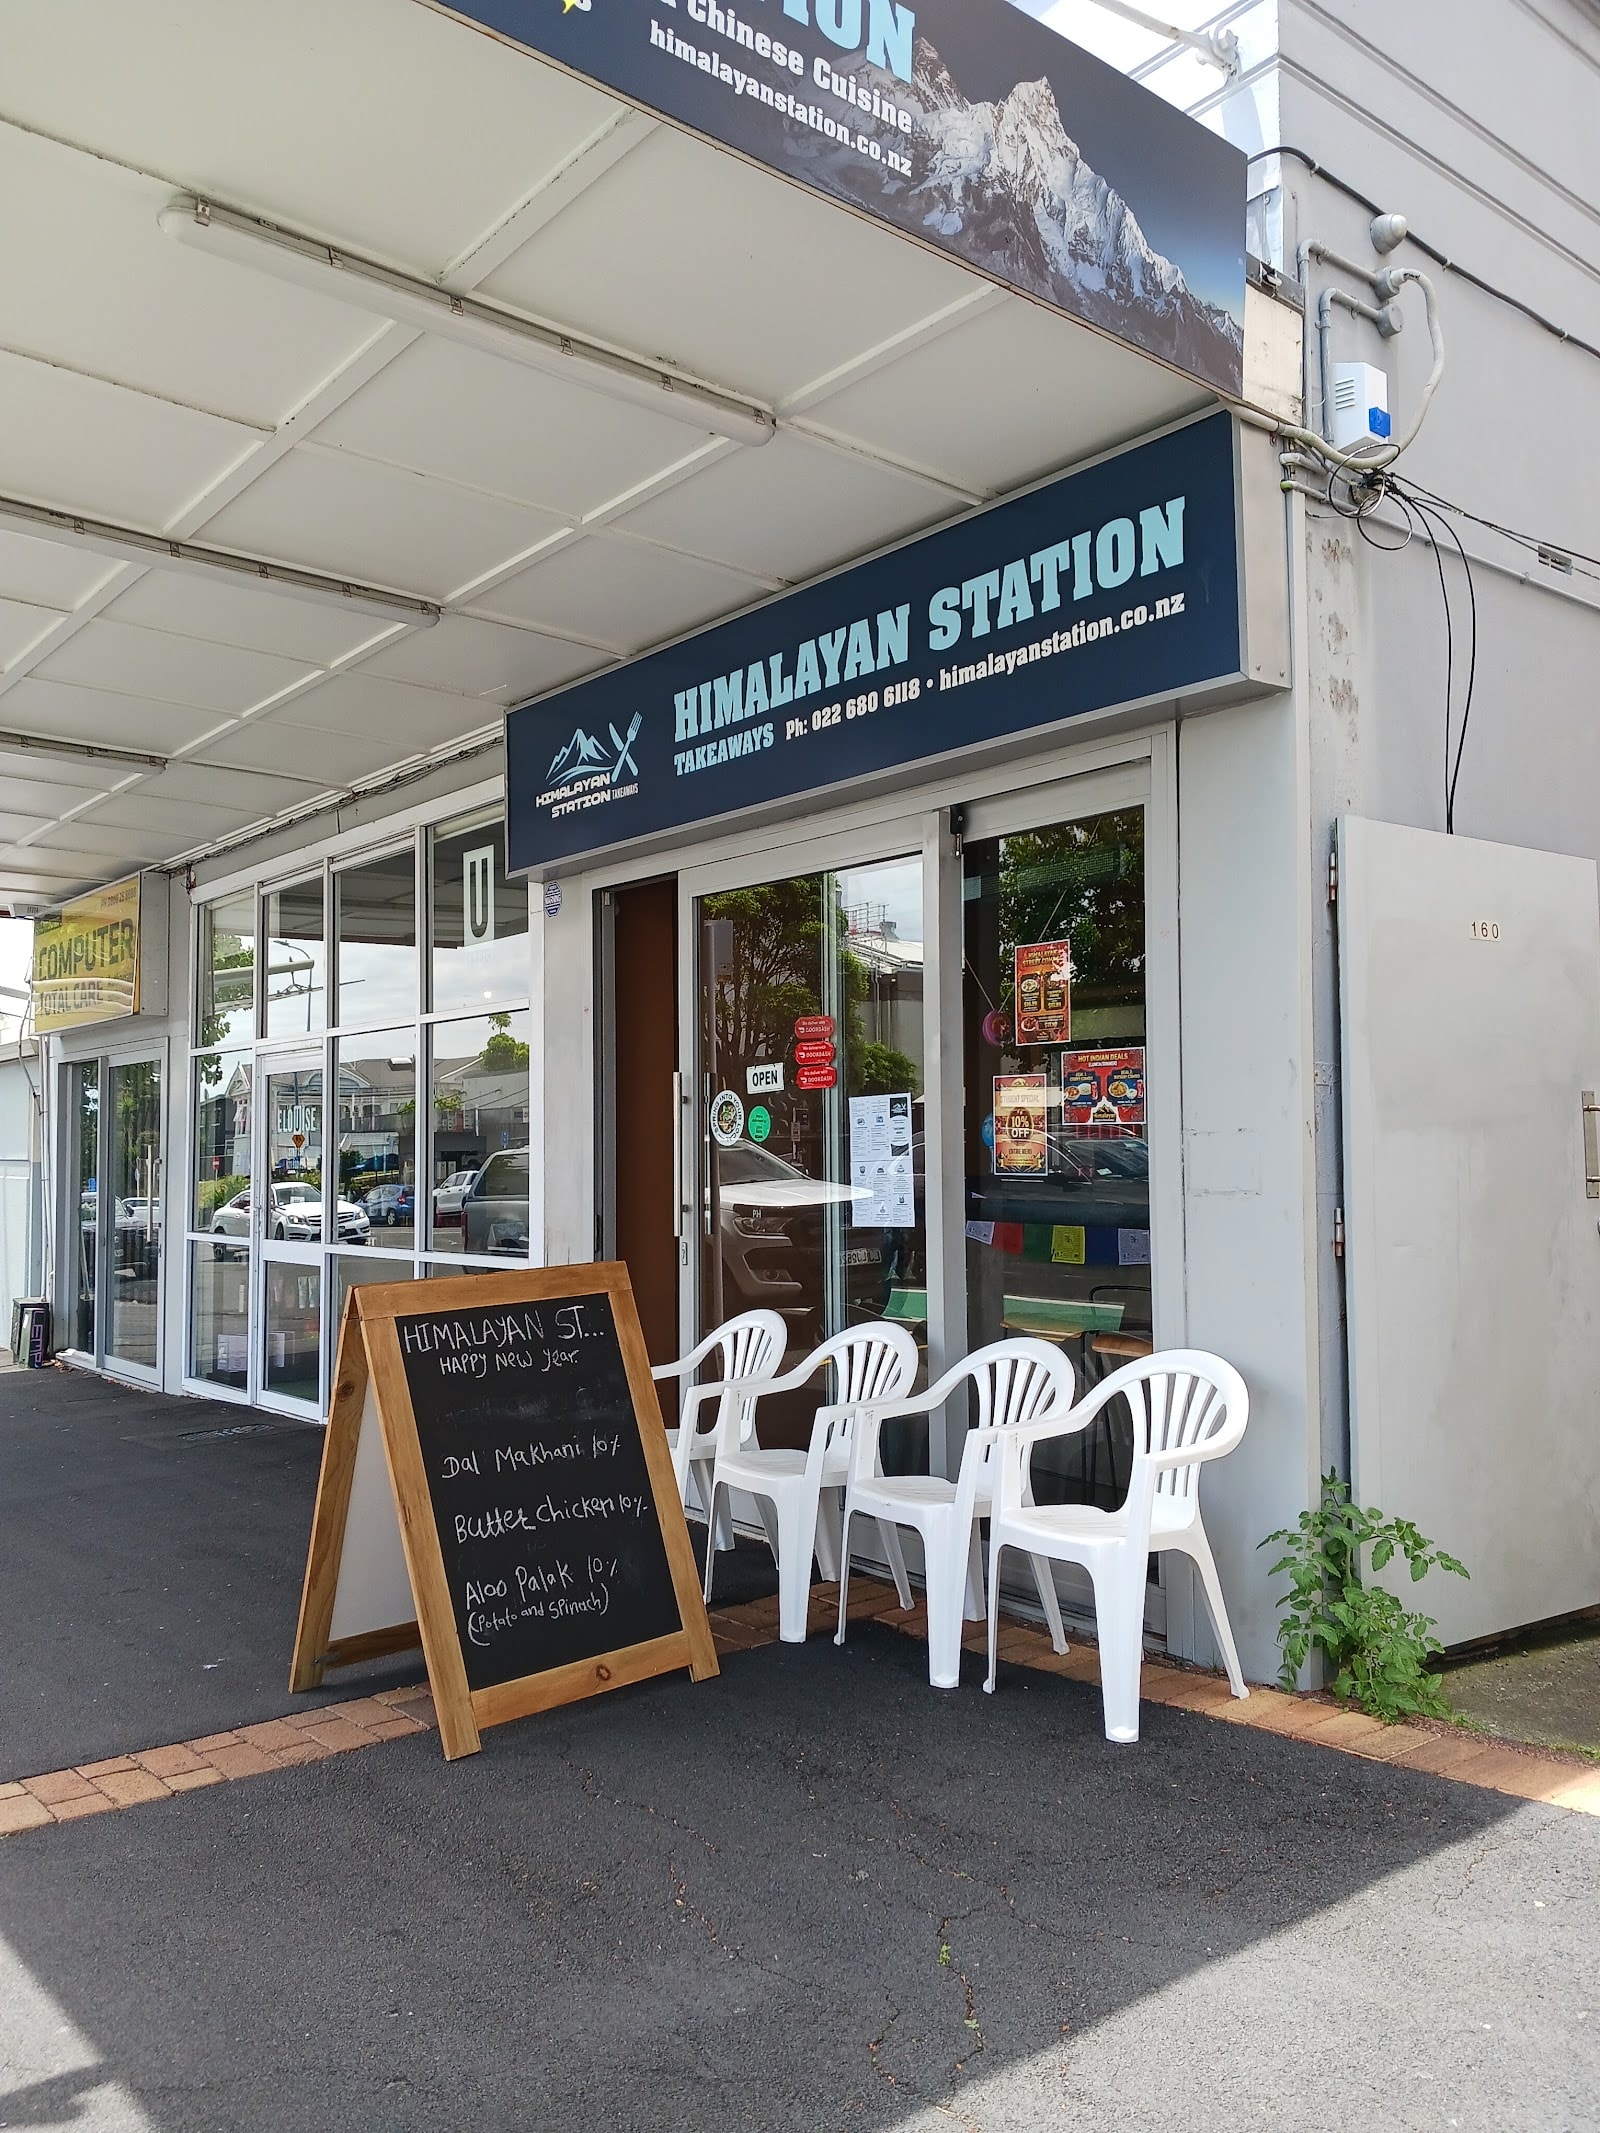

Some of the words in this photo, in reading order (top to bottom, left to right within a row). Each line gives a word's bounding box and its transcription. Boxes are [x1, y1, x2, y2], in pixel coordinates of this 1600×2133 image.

[687, 0, 804, 76] Chinese
[813, 57, 912, 134] Cuisine
[650, 19, 912, 178] himalayanstation.co.nz
[674, 604, 910, 743] HIMALAYAN
[929, 495, 1185, 651] STATION
[673, 722, 775, 777] TAKEAWAYS
[785, 717, 808, 741] Ph:
[811, 703, 842, 731] 022
[846, 691, 878, 720] 680
[883, 677, 921, 708] 6118
[939, 592, 1185, 692] himalayanstation.co.nz
[535, 772, 611, 808] HIMALAYAN
[551, 789, 611, 819] STATION
[611, 783, 639, 801] TAKEAWAYS
[467, 854, 490, 940] U
[1471, 921, 1499, 939] 160
[38, 918, 134, 982] COMPUTER
[1090, 1054, 1110, 1062] INDIAN
[1110, 1052, 1129, 1061] DEALS
[752, 1070, 778, 1087] OPEN
[277, 1105, 317, 1134] ELOUISE
[719, 1093, 733, 1102] INTO
[733, 1097, 742, 1121] YOUR
[1011, 1116, 1029, 1128] 10%
[1011, 1128, 1030, 1138] OFF
[403, 1309, 544, 1354] HIMALAYAN
[439, 1351, 487, 1379] HAPPY
[441, 1450, 480, 1479] Dal
[592, 1431, 621, 1459] 10%
[466, 1579, 507, 1611] Aloo
[587, 1554, 618, 1584] 10%
[520, 1601, 545, 1618] and
